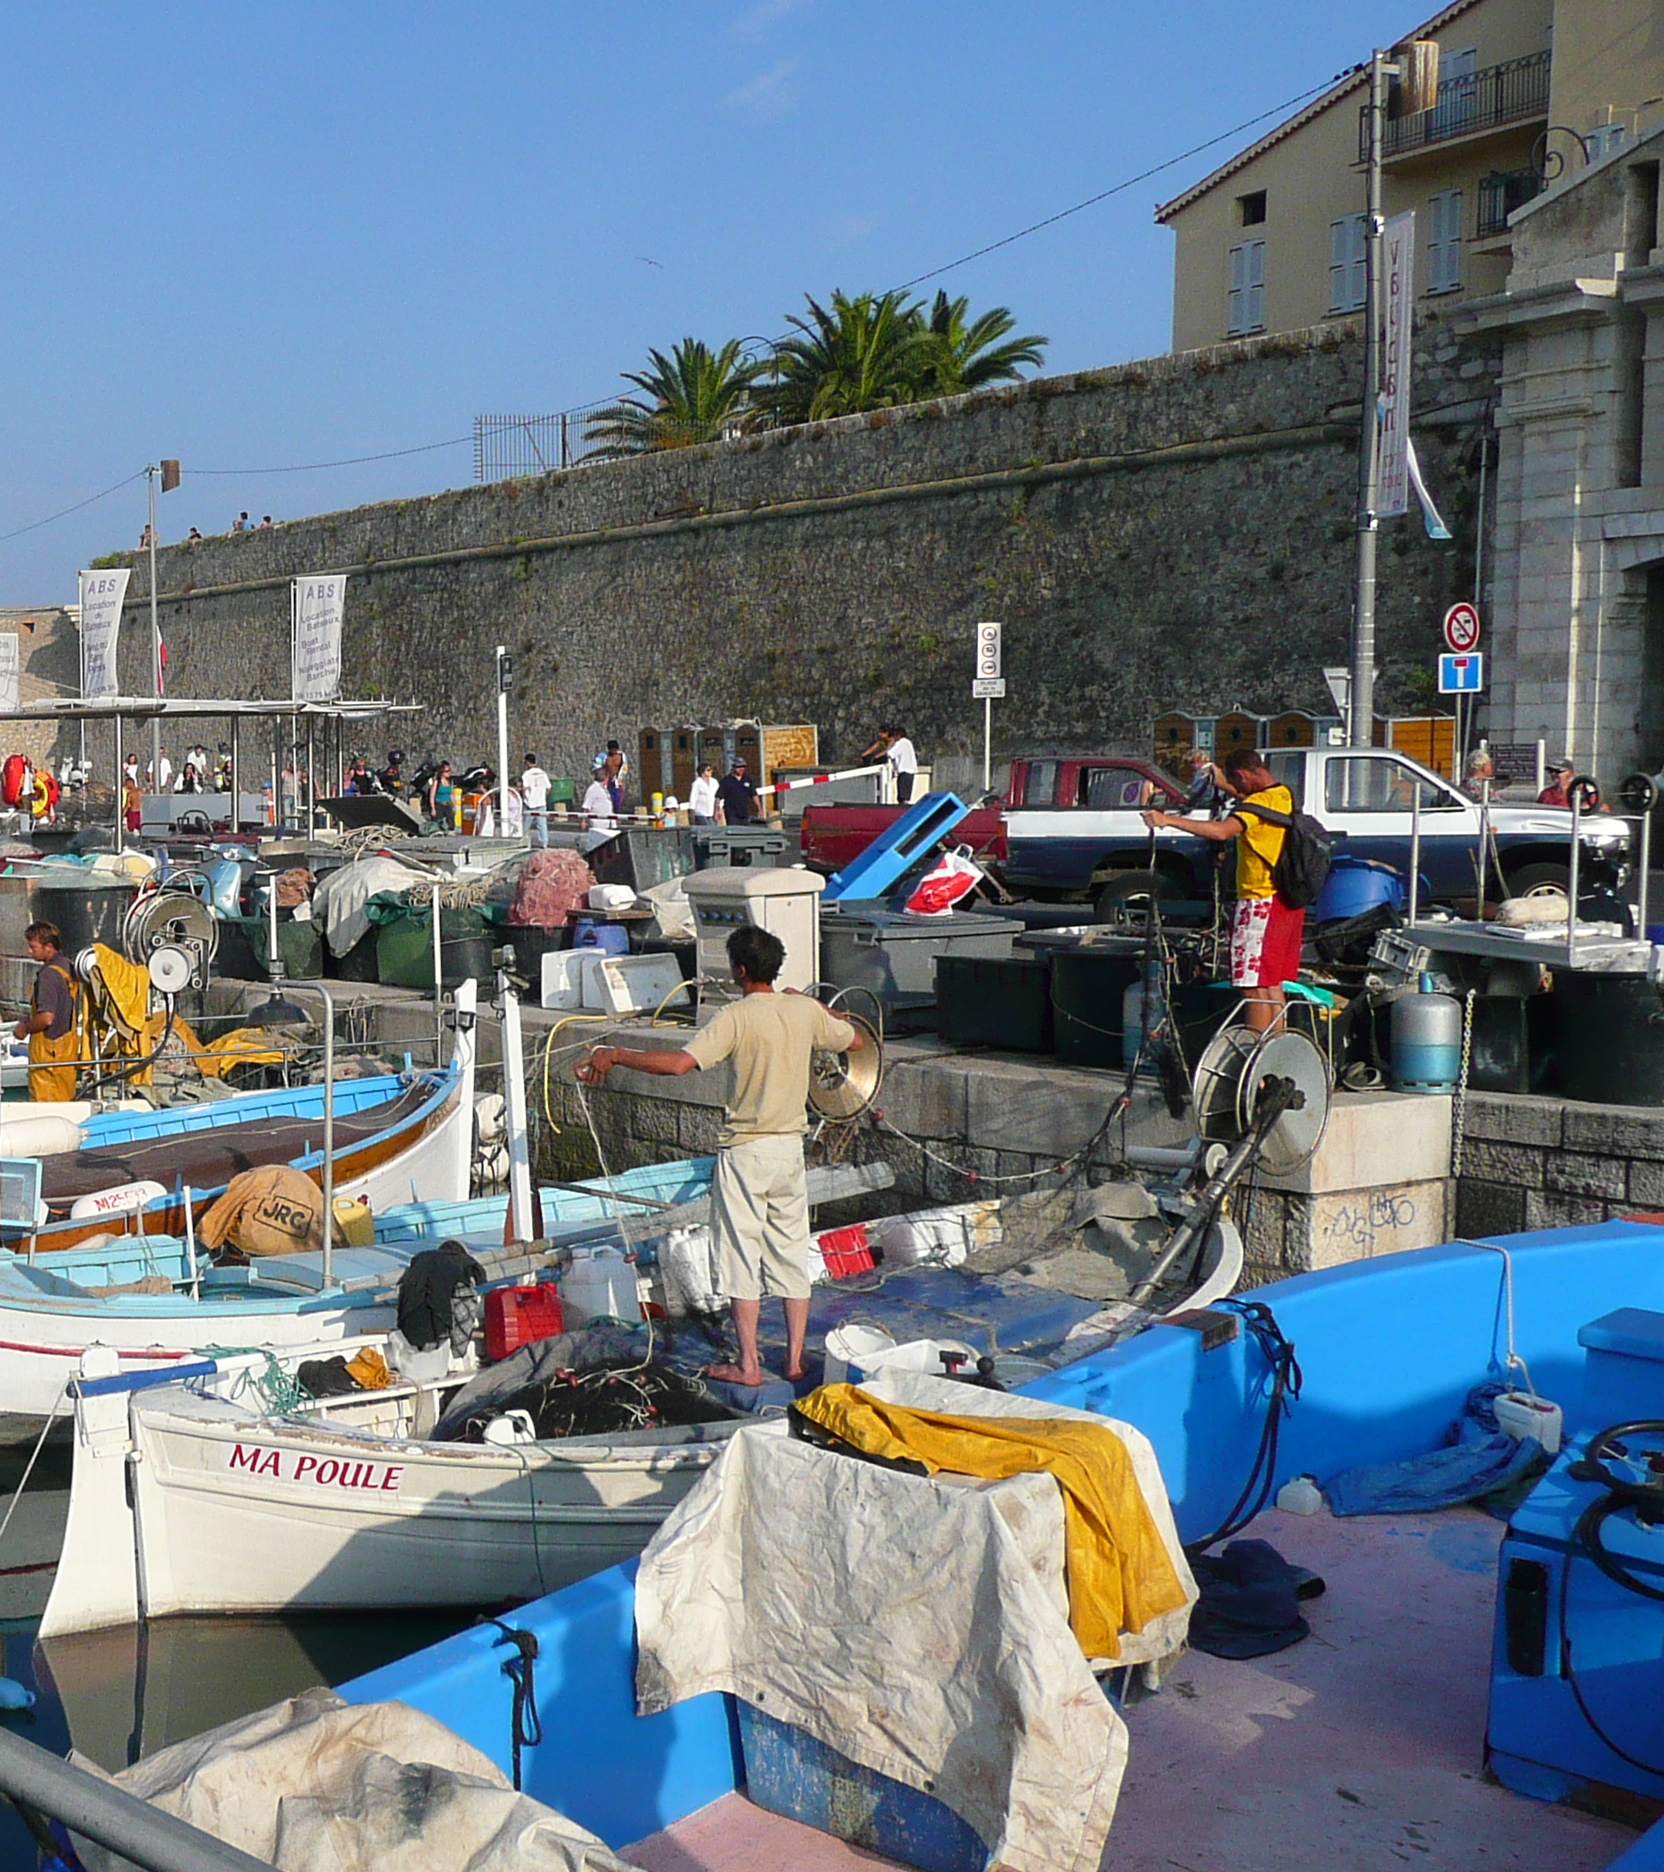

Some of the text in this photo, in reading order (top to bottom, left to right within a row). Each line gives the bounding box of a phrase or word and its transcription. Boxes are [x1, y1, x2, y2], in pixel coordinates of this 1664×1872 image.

[88, 579, 116, 595] ABS
[306, 584, 335, 599] ABS
[301, 607, 335, 623] Location
[302, 637, 319, 649] Boat
[262, 1202, 306, 1231] JRC
[229, 1444, 404, 1490] MA POULE
